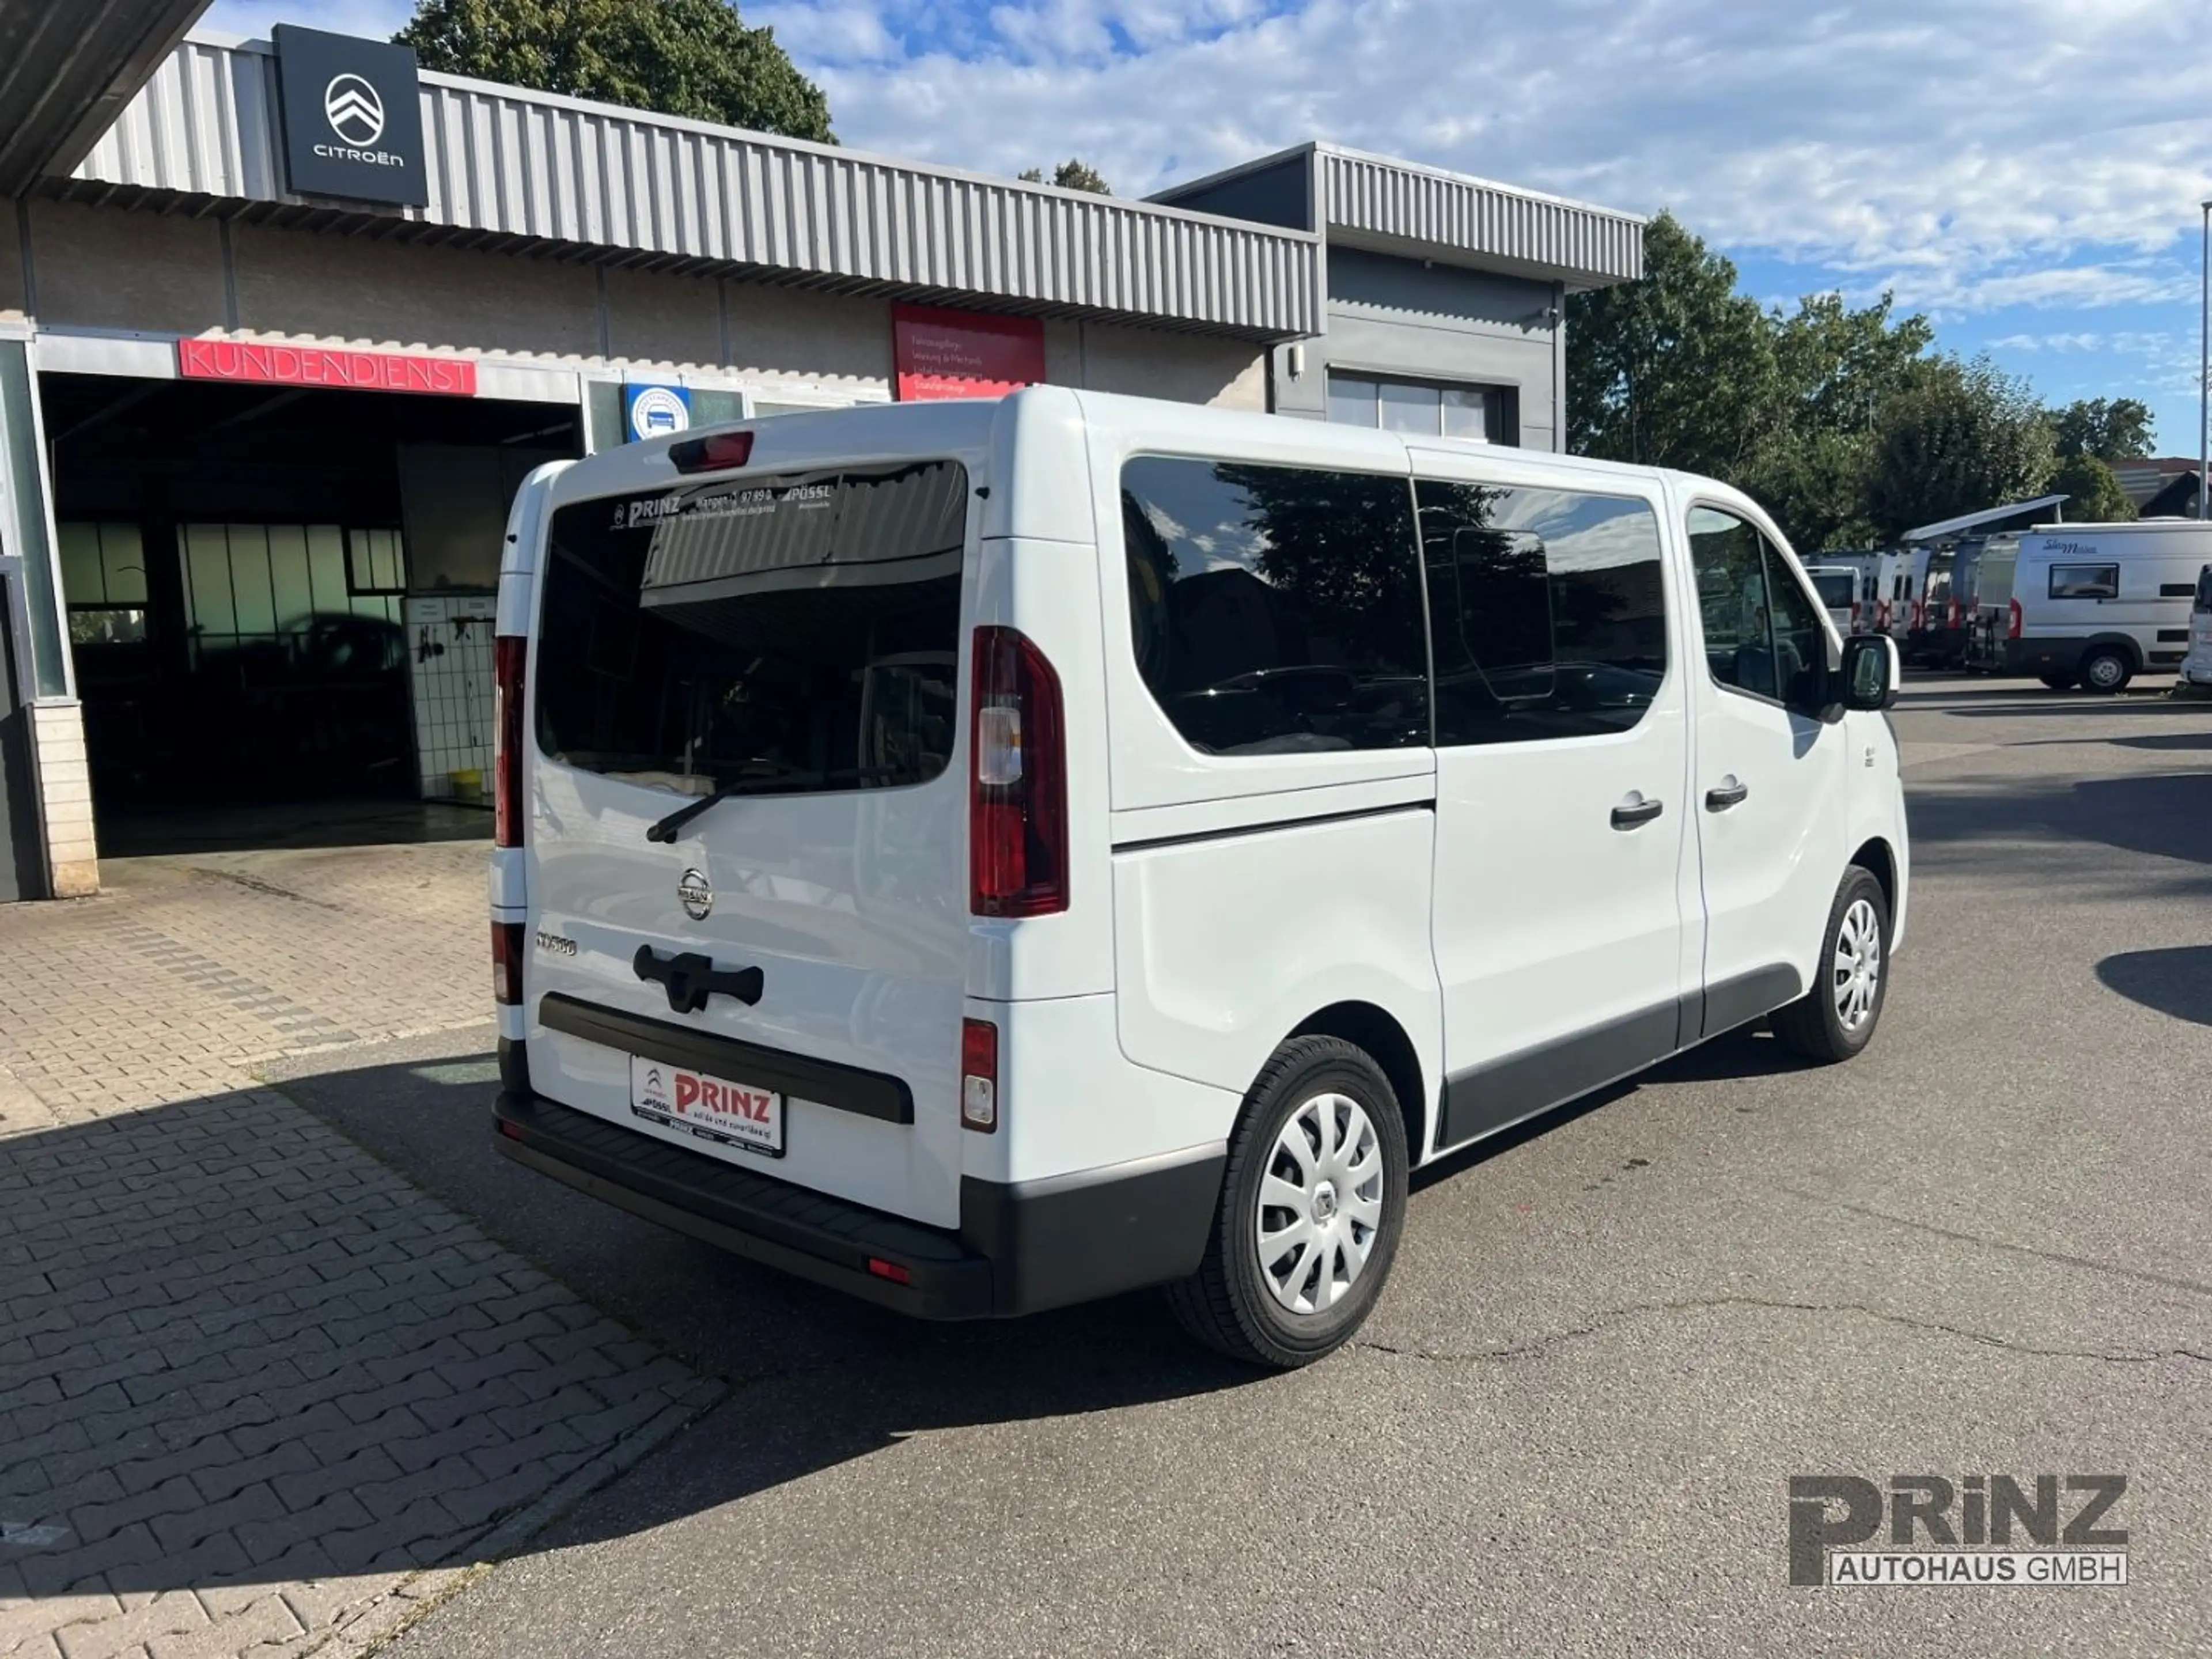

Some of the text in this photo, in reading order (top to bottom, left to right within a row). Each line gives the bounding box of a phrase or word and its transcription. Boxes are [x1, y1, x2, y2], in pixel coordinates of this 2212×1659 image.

[185, 341, 474, 390] KUNDENDIENST
[628, 495, 680, 528] PRINZ
[790, 484, 831, 501] PÖSSL
[675, 1073, 771, 1123] PRINZ
